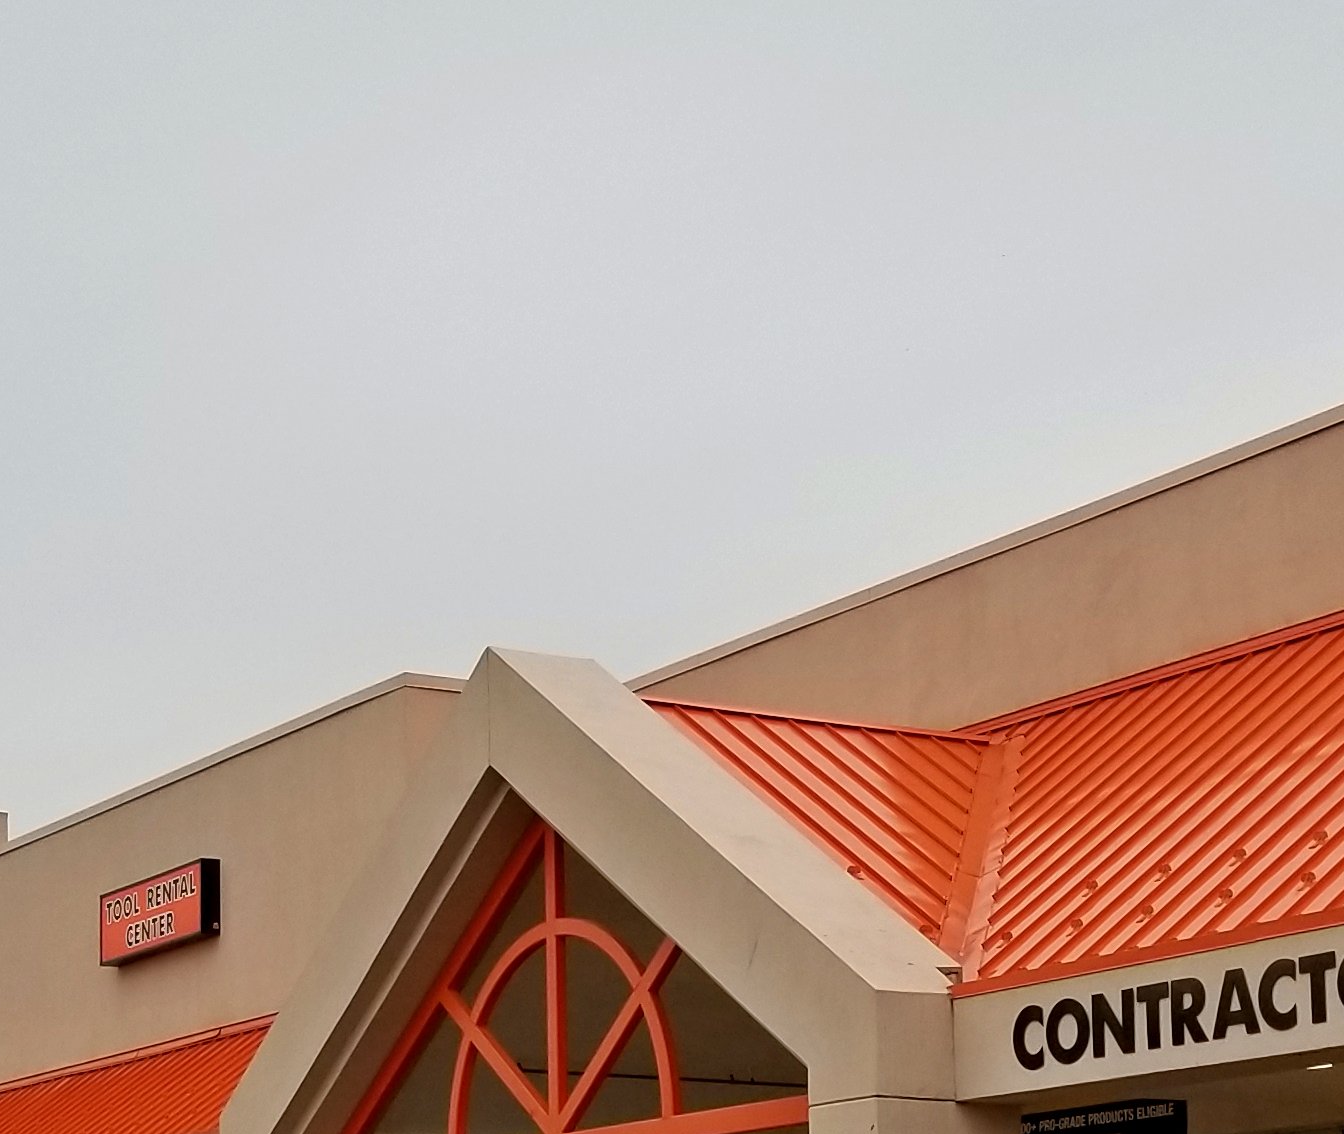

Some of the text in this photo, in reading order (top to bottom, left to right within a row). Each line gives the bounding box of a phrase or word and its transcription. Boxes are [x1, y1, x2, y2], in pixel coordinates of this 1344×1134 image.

[106, 870, 196, 925] TOOL RENTAL
[125, 911, 175, 948] CENTER
[1039, 1114, 1086, 1132] PRO-GRADE
[1088, 1108, 1134, 1126] PRODUCTS
[1136, 1102, 1175, 1120] ELIGIBLE
